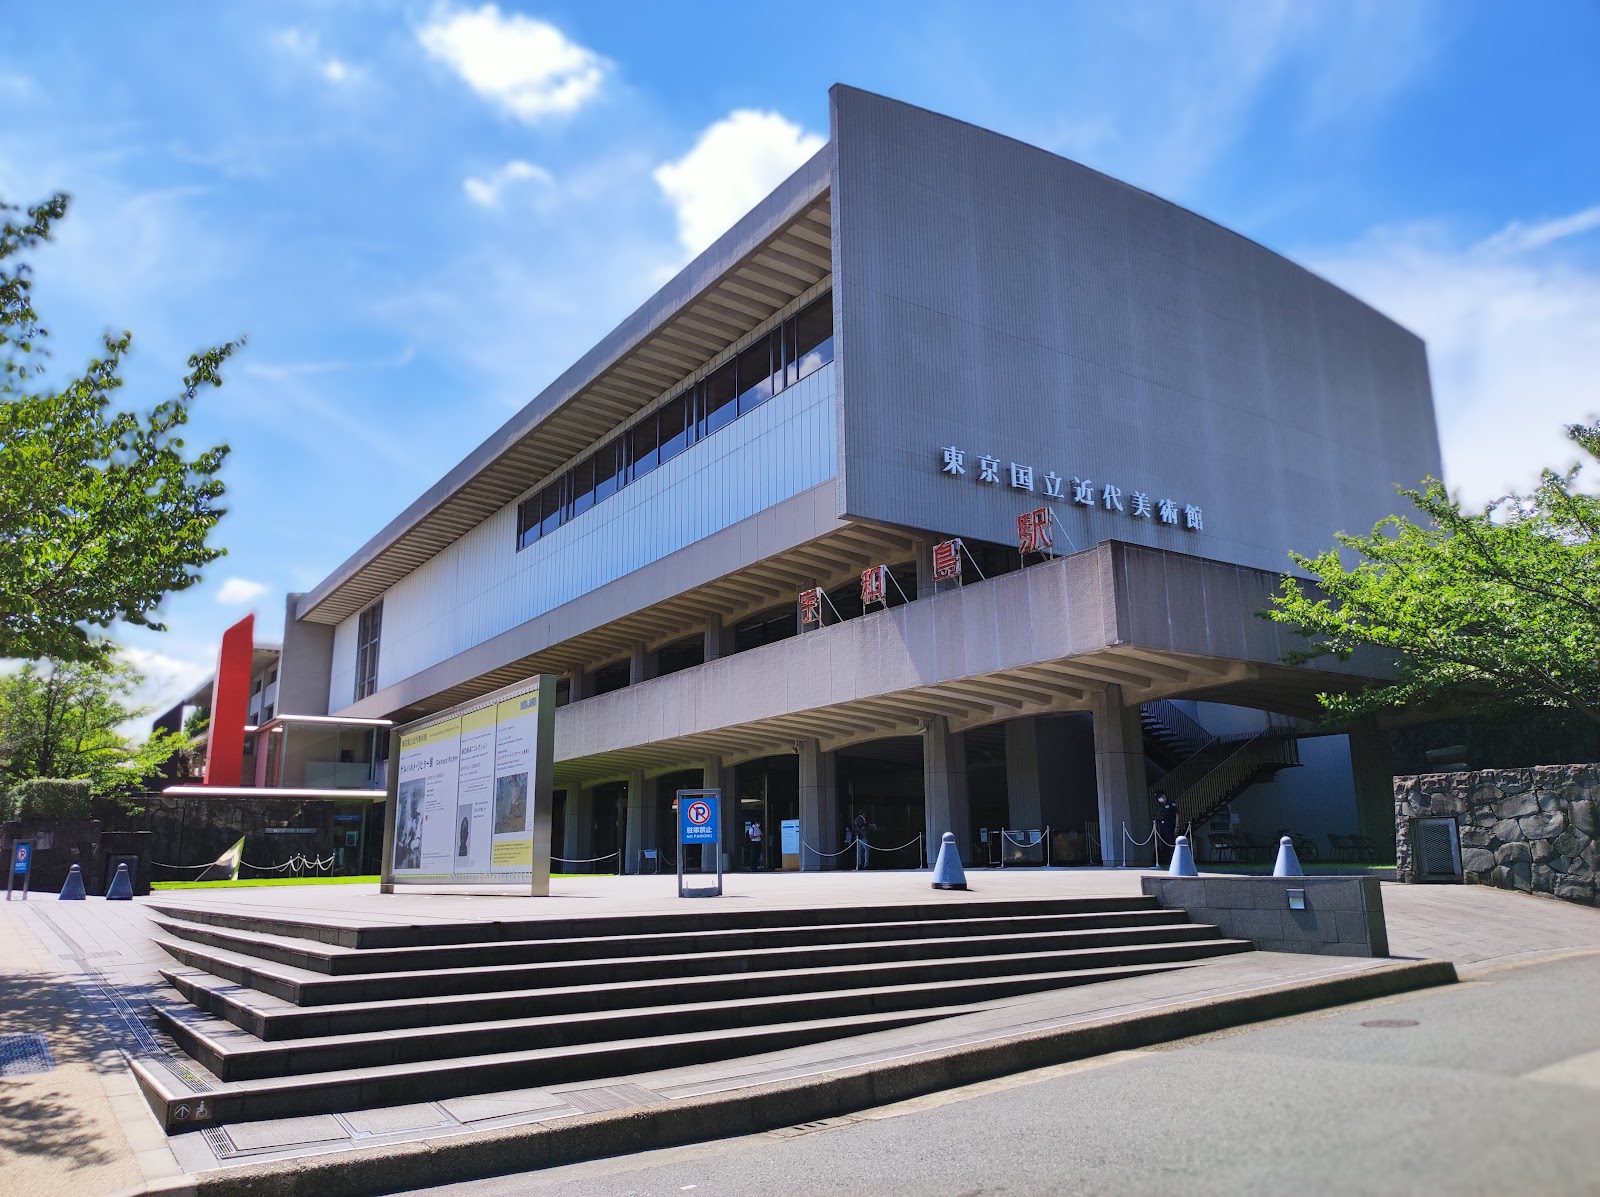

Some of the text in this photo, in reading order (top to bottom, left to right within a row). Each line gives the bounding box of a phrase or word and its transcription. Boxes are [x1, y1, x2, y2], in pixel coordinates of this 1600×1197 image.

[941, 446, 1203, 530] 東京国立近代美術館
[686, 826, 712, 834] 駐車禁止
